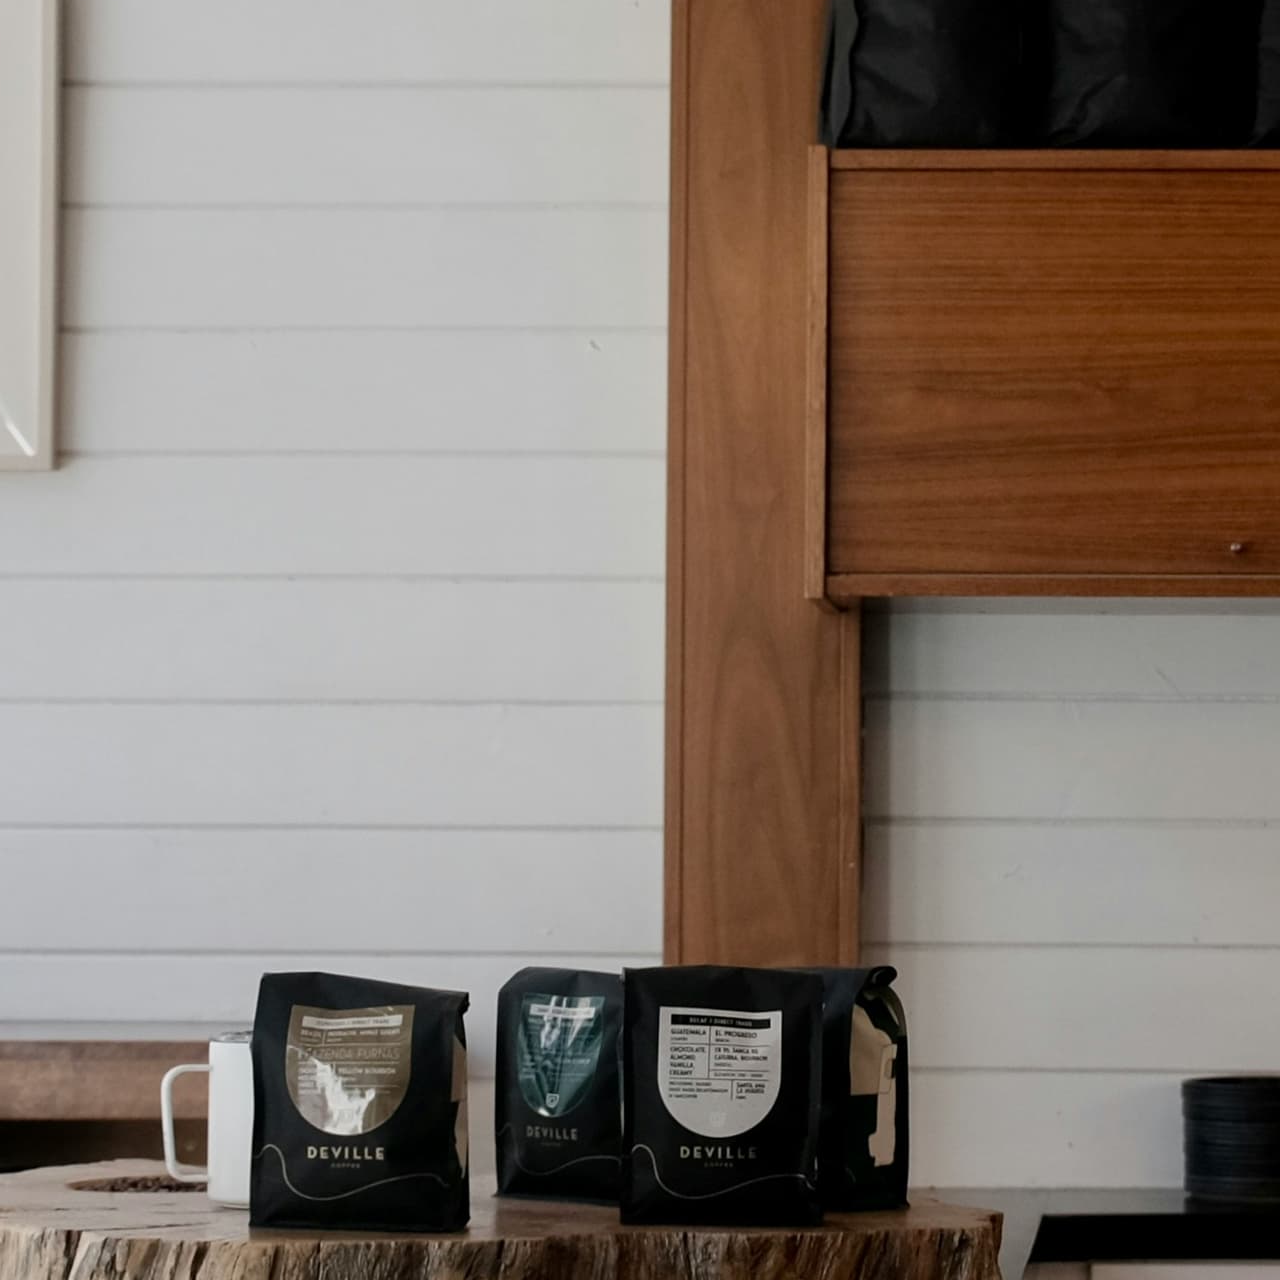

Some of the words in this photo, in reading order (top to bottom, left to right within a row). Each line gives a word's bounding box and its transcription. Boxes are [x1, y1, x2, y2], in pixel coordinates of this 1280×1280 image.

[527, 1126, 578, 1141] DEVILLE
[307, 1145, 385, 1161] DEVILLE
[680, 1145, 758, 1160] DEVILLE
